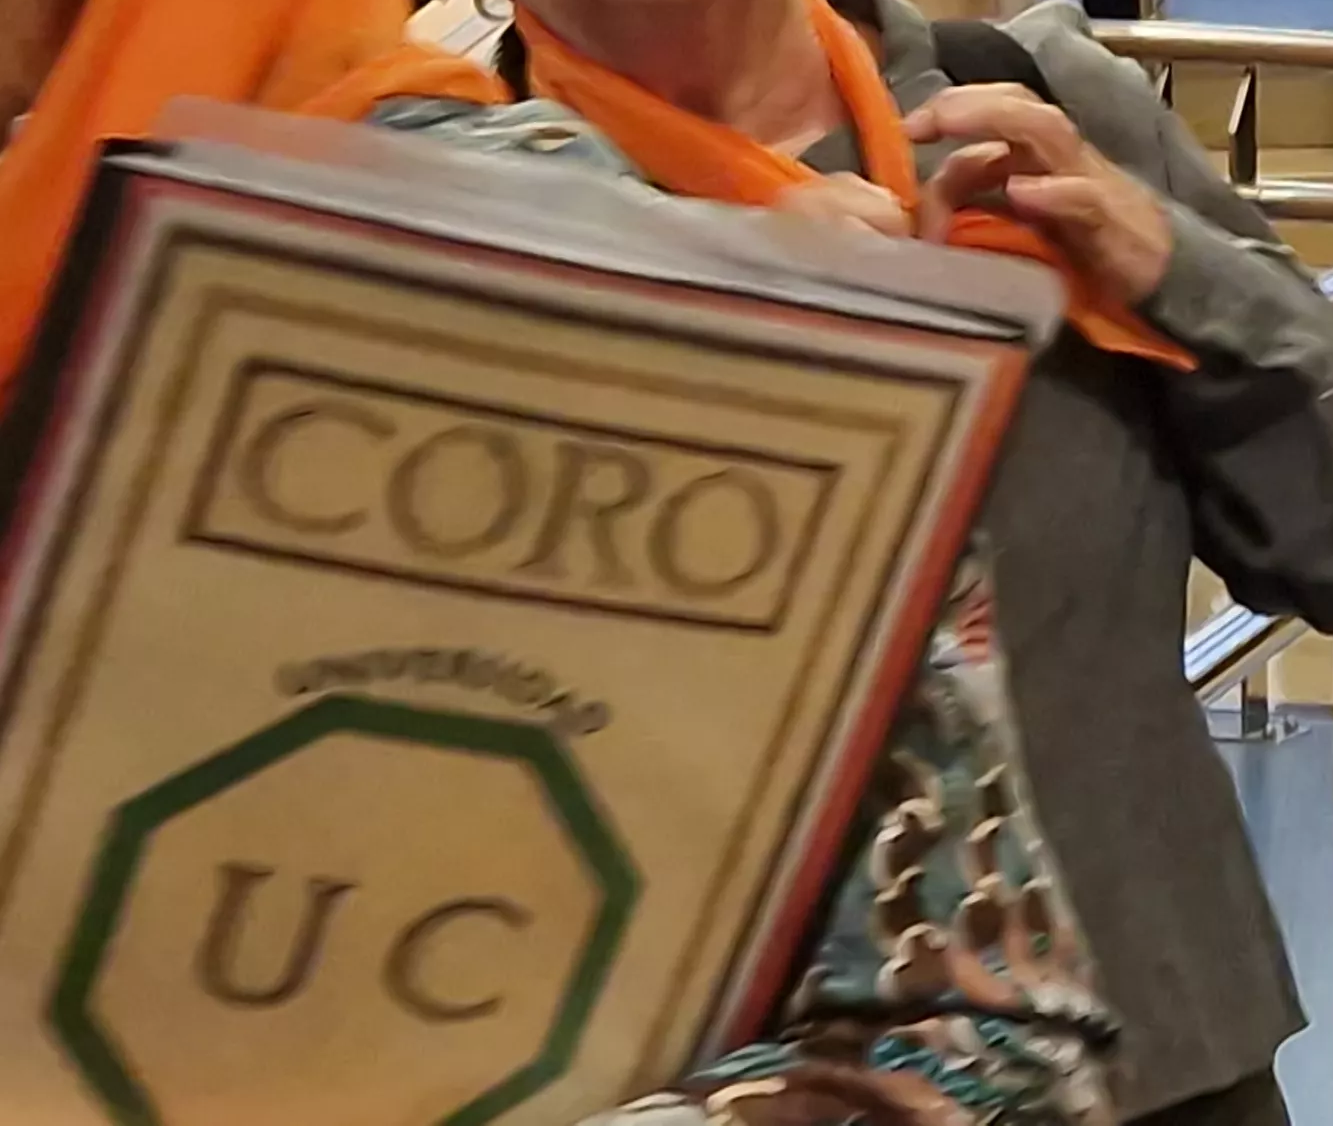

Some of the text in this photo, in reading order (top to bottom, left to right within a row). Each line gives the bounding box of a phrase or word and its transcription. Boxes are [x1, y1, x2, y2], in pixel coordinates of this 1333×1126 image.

[238, 396, 780, 601] CORO
[193, 860, 534, 1026] U C
